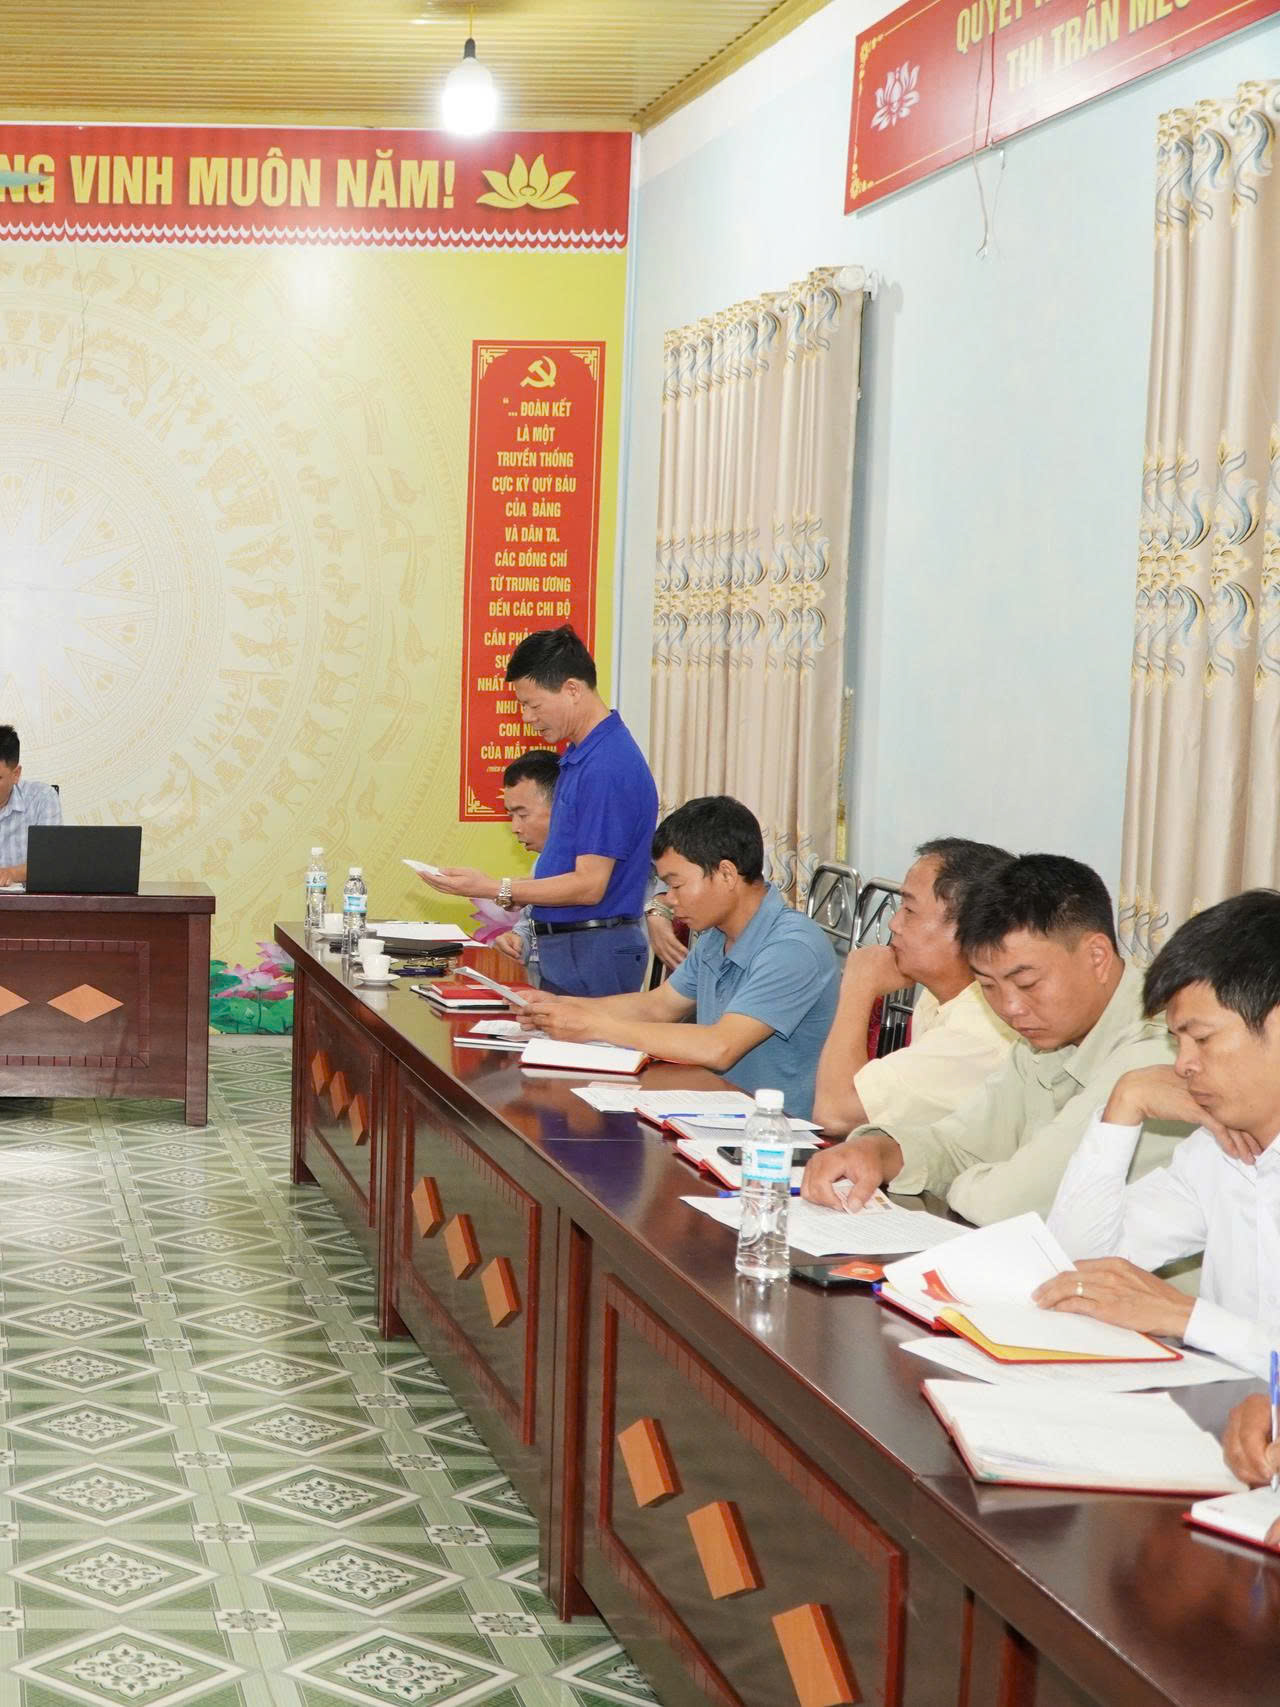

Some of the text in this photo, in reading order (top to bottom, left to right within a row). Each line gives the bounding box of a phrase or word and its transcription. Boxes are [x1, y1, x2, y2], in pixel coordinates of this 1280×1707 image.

[70, 155, 173, 205] VINH
[189, 147, 321, 207] MUÔN
[337, 148, 455, 209] NĂM!
[532, 424, 555, 445] MỘT
[505, 497, 561, 517] CỦA ĐẢNG
[495, 549, 516, 566] CÁC
[550, 549, 568, 567] CHÍ
[506, 576, 539, 592] TRUNG
[513, 599, 533, 616] CÁC
[536, 602, 553, 616] CHI
[556, 599, 571, 619] BỘ
[499, 722, 521, 737] CON
[481, 741, 502, 759] CỦA
